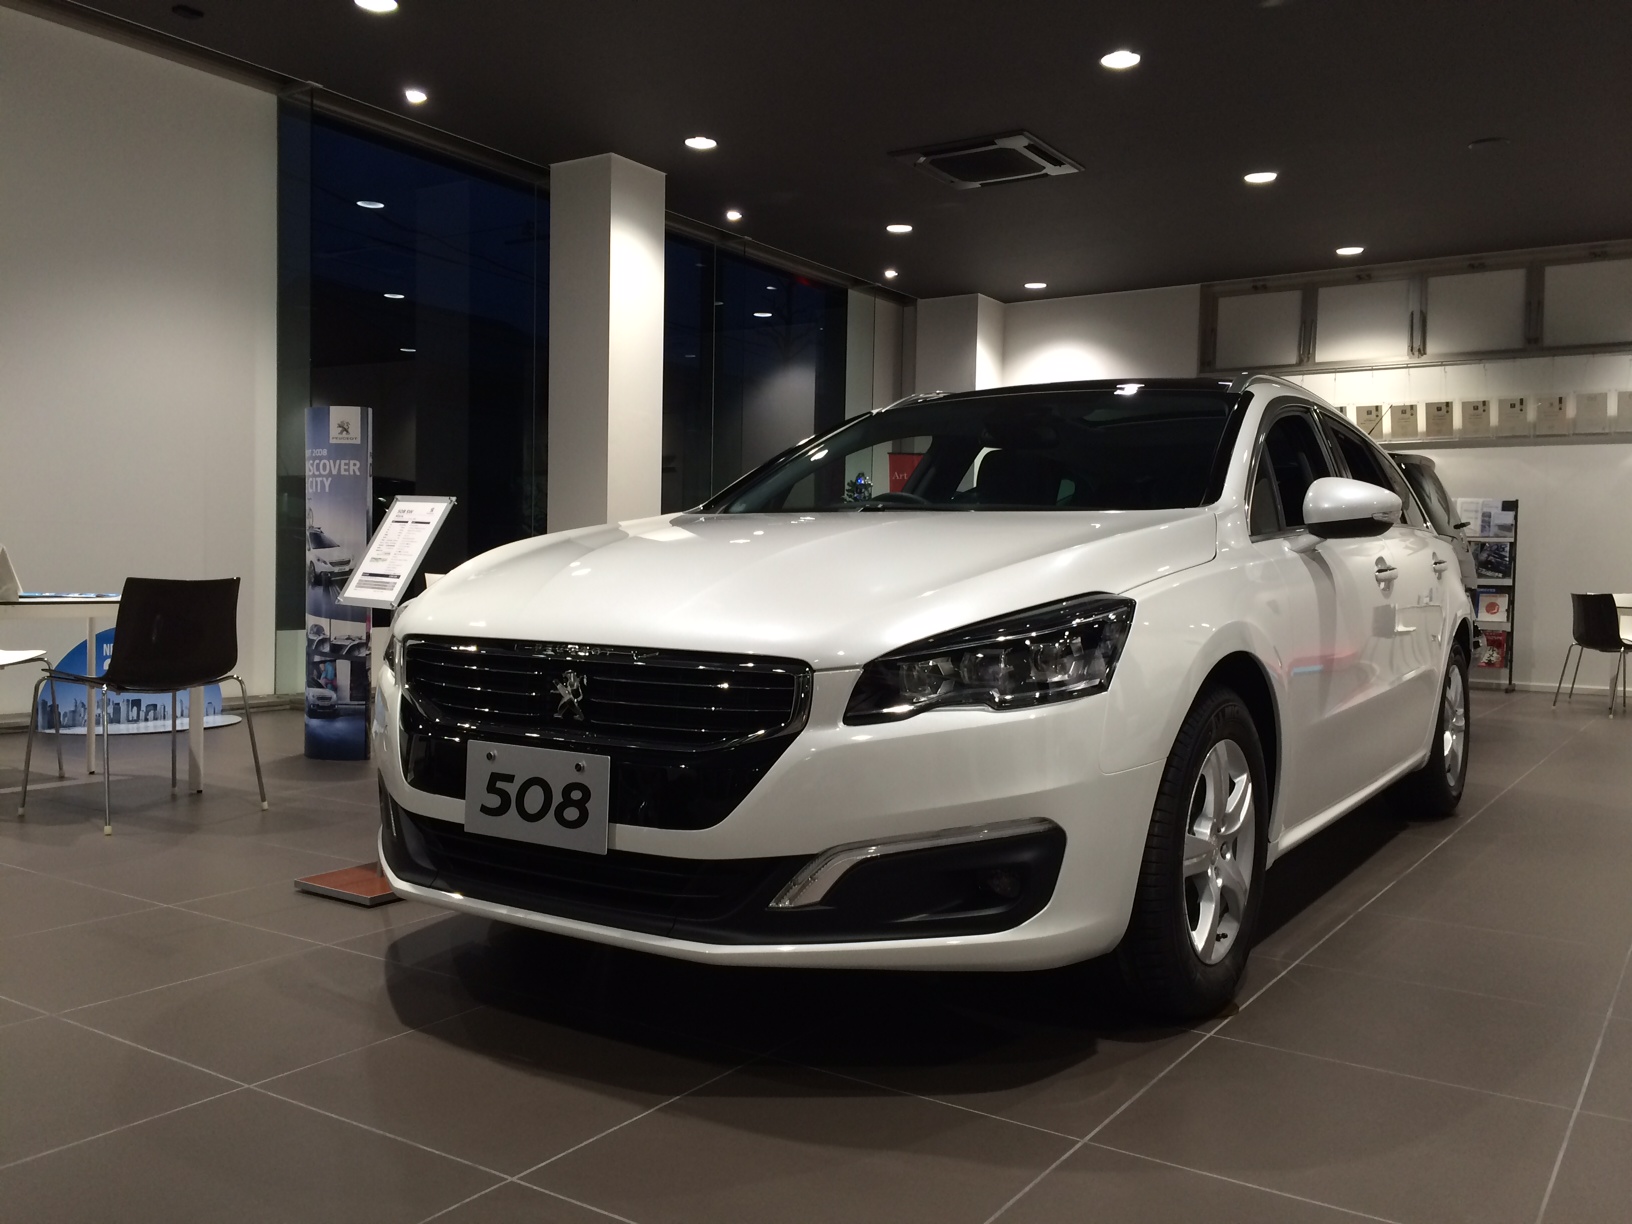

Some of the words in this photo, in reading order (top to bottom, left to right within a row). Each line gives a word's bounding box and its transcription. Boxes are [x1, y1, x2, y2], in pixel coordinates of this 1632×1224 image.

[312, 448, 328, 457] 2008
[892, 471, 908, 480] Art
[308, 477, 332, 493] CITY
[479, 771, 592, 830] 508
